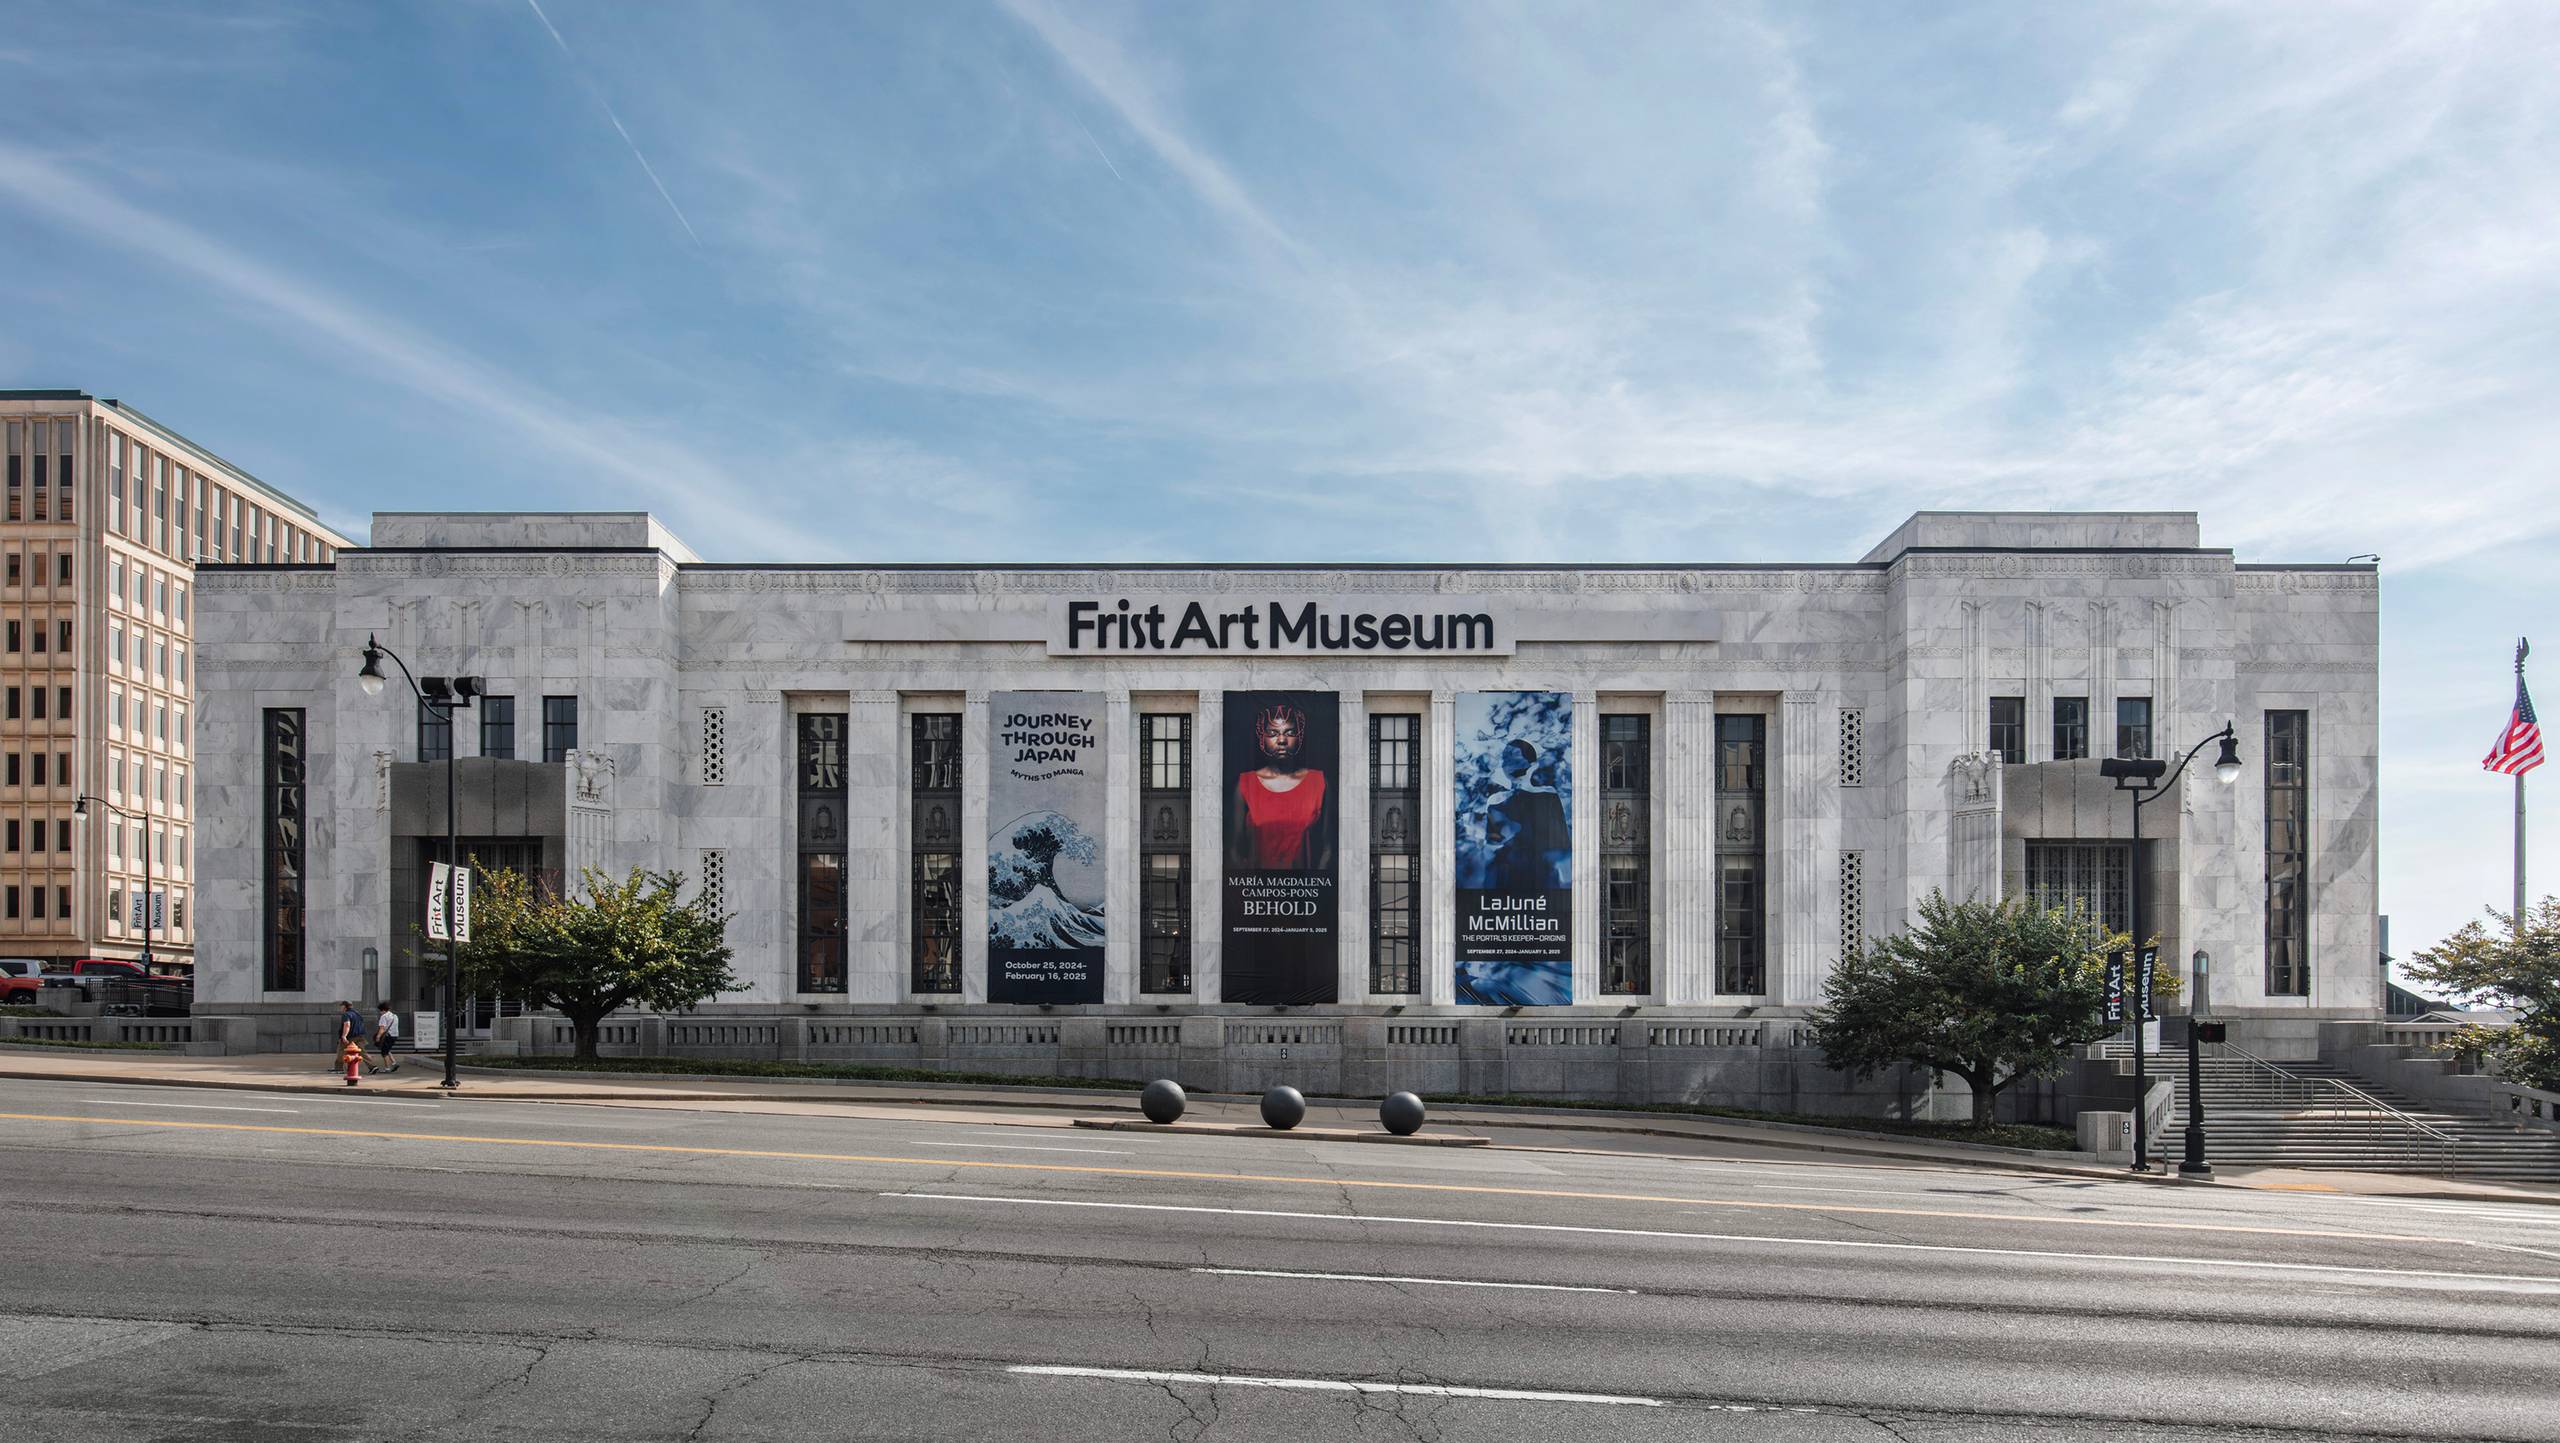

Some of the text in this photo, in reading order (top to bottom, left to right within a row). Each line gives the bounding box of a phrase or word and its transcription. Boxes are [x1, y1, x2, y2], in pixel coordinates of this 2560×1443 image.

[1069, 599, 1494, 649] Frist Art Museum
[1004, 713, 1092, 732] JOURNEY
[1001, 731, 1095, 748] THROUGH
[1014, 748, 1076, 764] JAPAN
[1011, 769, 1040, 782] MYTHS
[1053, 768, 1084, 777] MANGA
[1228, 875, 1332, 887] MARÍA MAGDALENA
[1242, 888, 1319, 898] CAMPOS-PONS
[153, 894, 162, 928] Museum
[432, 879, 444, 935] Frist Art
[456, 872, 465, 937] Museum
[1243, 901, 1317, 916] BEHOLD
[1481, 895, 1547, 911] LaJuné
[1469, 914, 1558, 931] McMillian
[1462, 934, 1475, 942] THE
[1005, 961, 1041, 969] October
[1042, 961, 1057, 970] 25,
[1005, 972, 1087, 981] February 16, 2025
[2109, 964, 2121, 990] Art
[2140, 952, 2153, 1019] Museum
